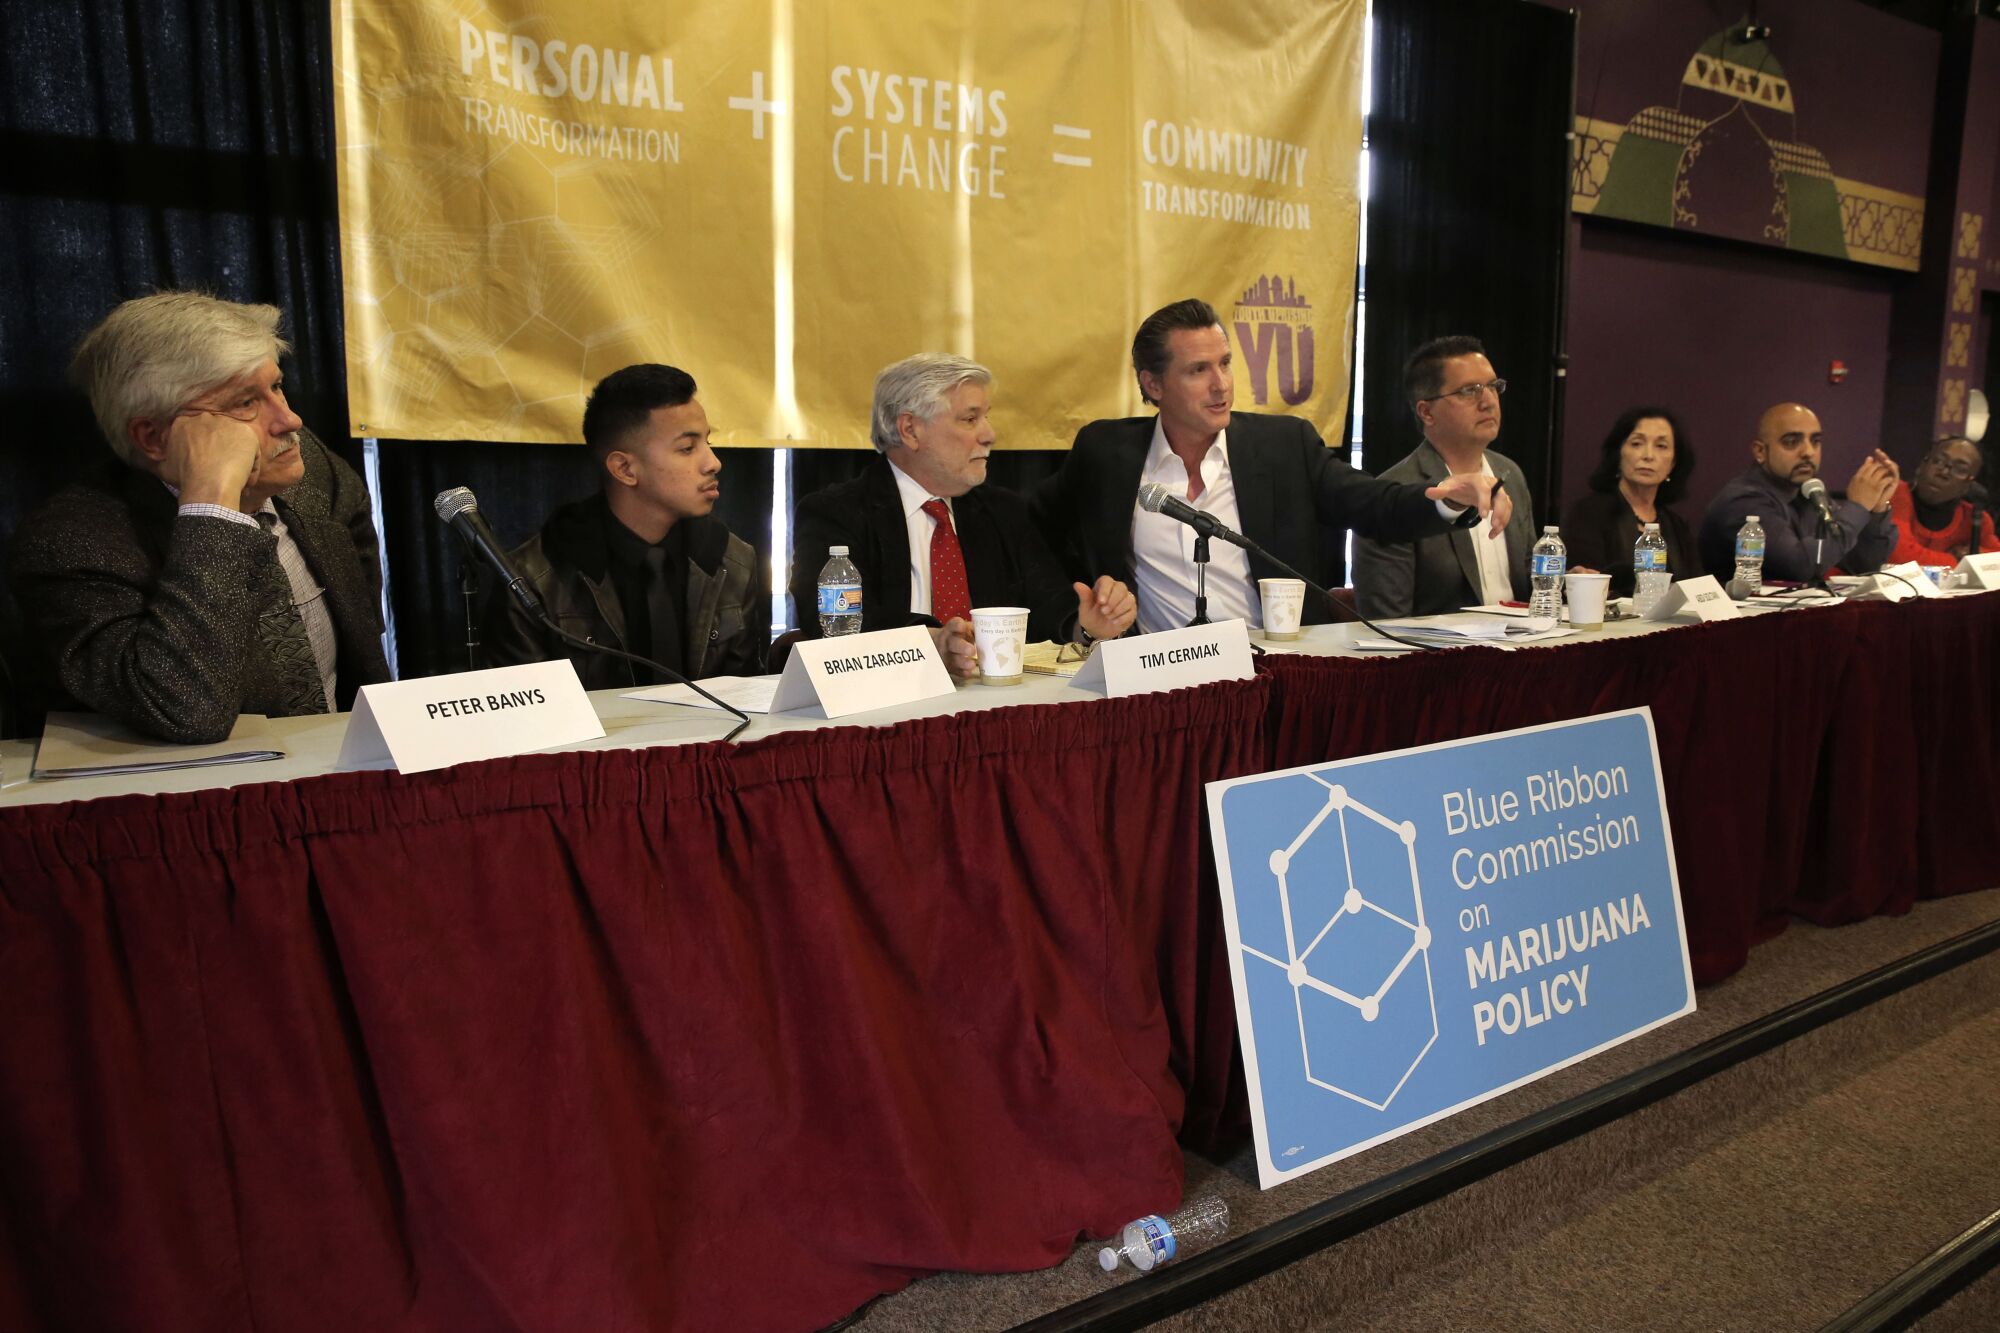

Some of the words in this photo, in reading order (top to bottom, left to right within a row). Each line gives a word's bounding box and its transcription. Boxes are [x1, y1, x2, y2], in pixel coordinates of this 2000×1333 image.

[459, 17, 684, 112] PERSONAL
[459, 95, 680, 164] TRANSFORMATION
[831, 65, 1008, 138] SYSTEMS
[832, 125, 1007, 199] CHANGE
[1142, 118, 1308, 188] COMMUNITY
[1142, 181, 1312, 231] TRANSFORMATION
[1233, 322, 1315, 407] YU
[823, 655, 864, 675] BRIAN
[864, 647, 926, 670] ZARAGOZA
[1139, 652, 1165, 669] TIM
[1168, 642, 1220, 664] CERMAK
[425, 698, 485, 720] PETER
[486, 688, 546, 711] BANYS
[1442, 787, 1519, 836] Blue
[1526, 765, 1629, 816] Ribbon
[1451, 813, 1640, 890] Commission
[1458, 903, 1490, 932] on
[1464, 893, 1651, 990] MARIJUANA
[1472, 964, 1590, 1047] POLICY
